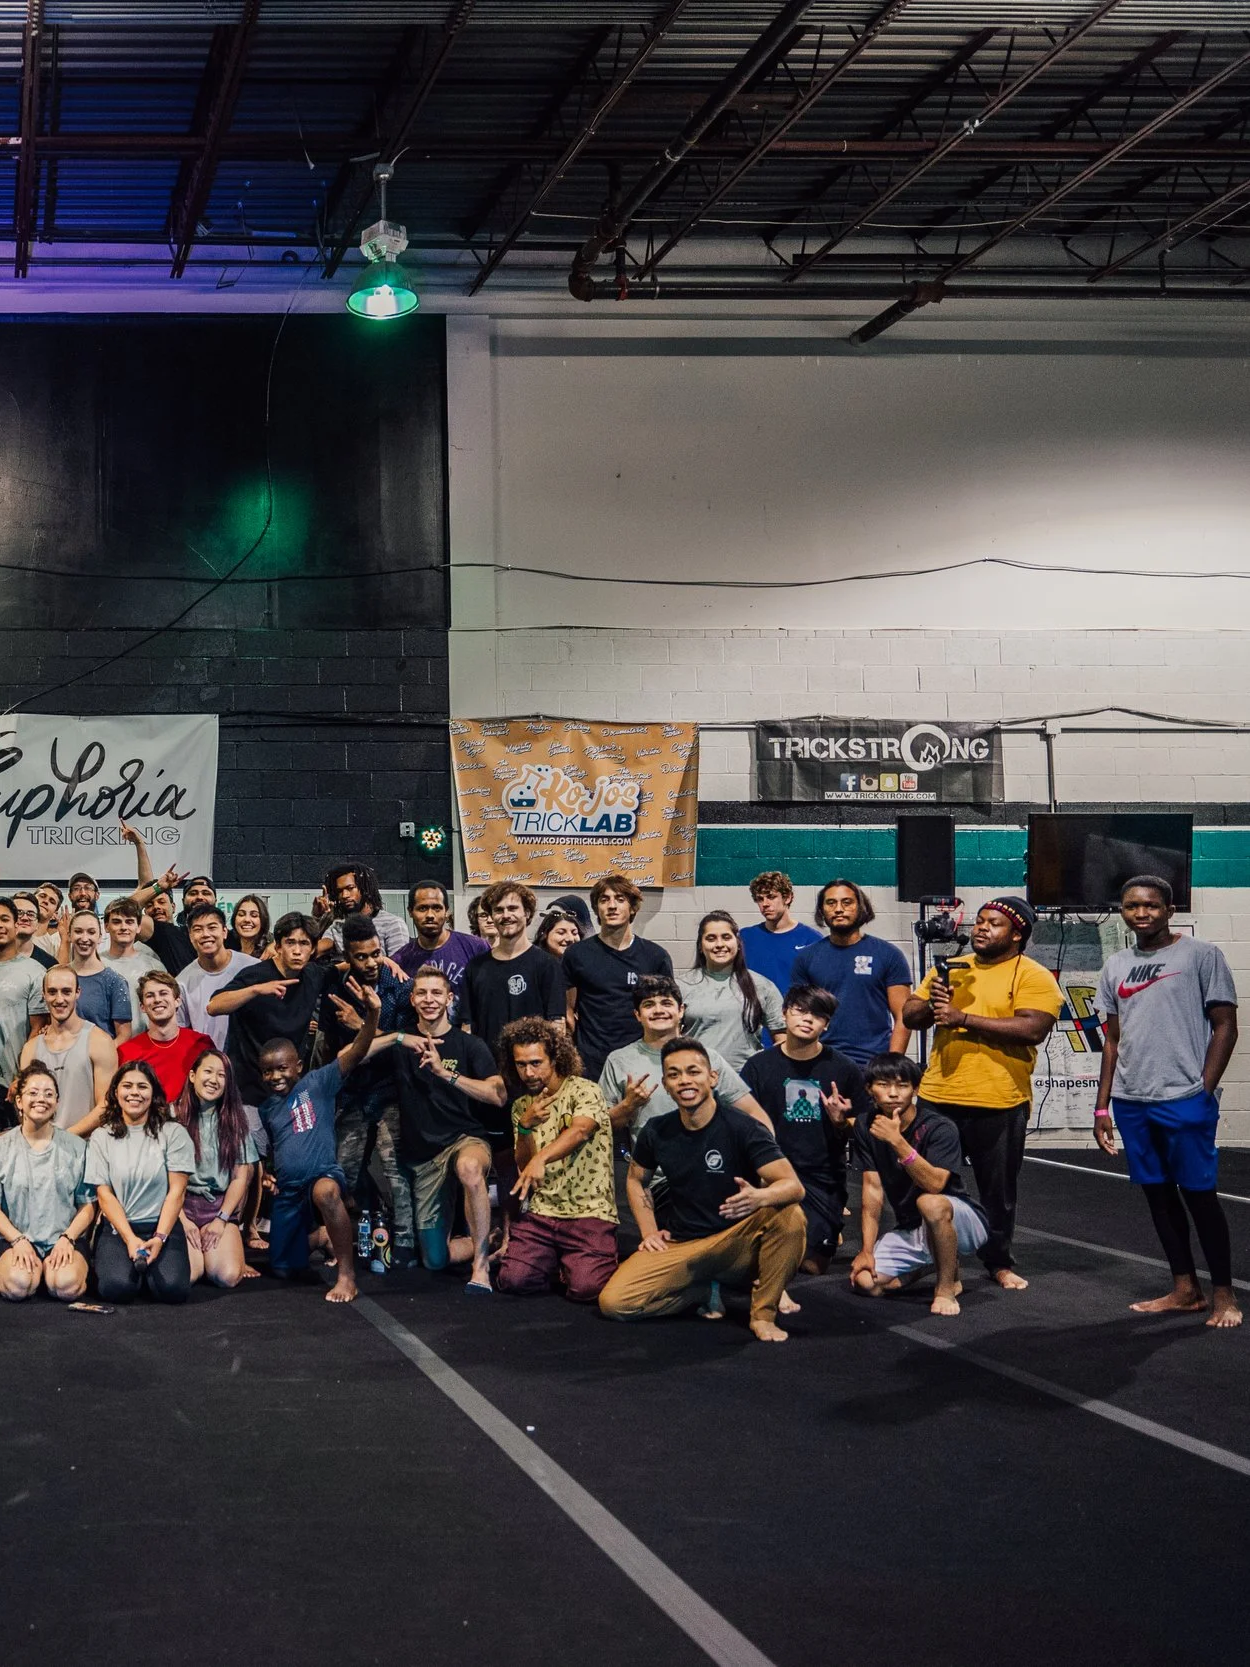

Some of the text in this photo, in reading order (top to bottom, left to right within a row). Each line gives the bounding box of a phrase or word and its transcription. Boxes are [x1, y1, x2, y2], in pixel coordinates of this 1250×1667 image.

[768, 724, 990, 771] TRICKSTRONG
[825, 792, 936, 800] WWW.TRICKSTRONG.COM
[26, 825, 181, 845] TRICKING
[514, 837, 632, 846] WWW.KOJOSTRICKLAB.COM
[1125, 963, 1167, 983] NIKE
